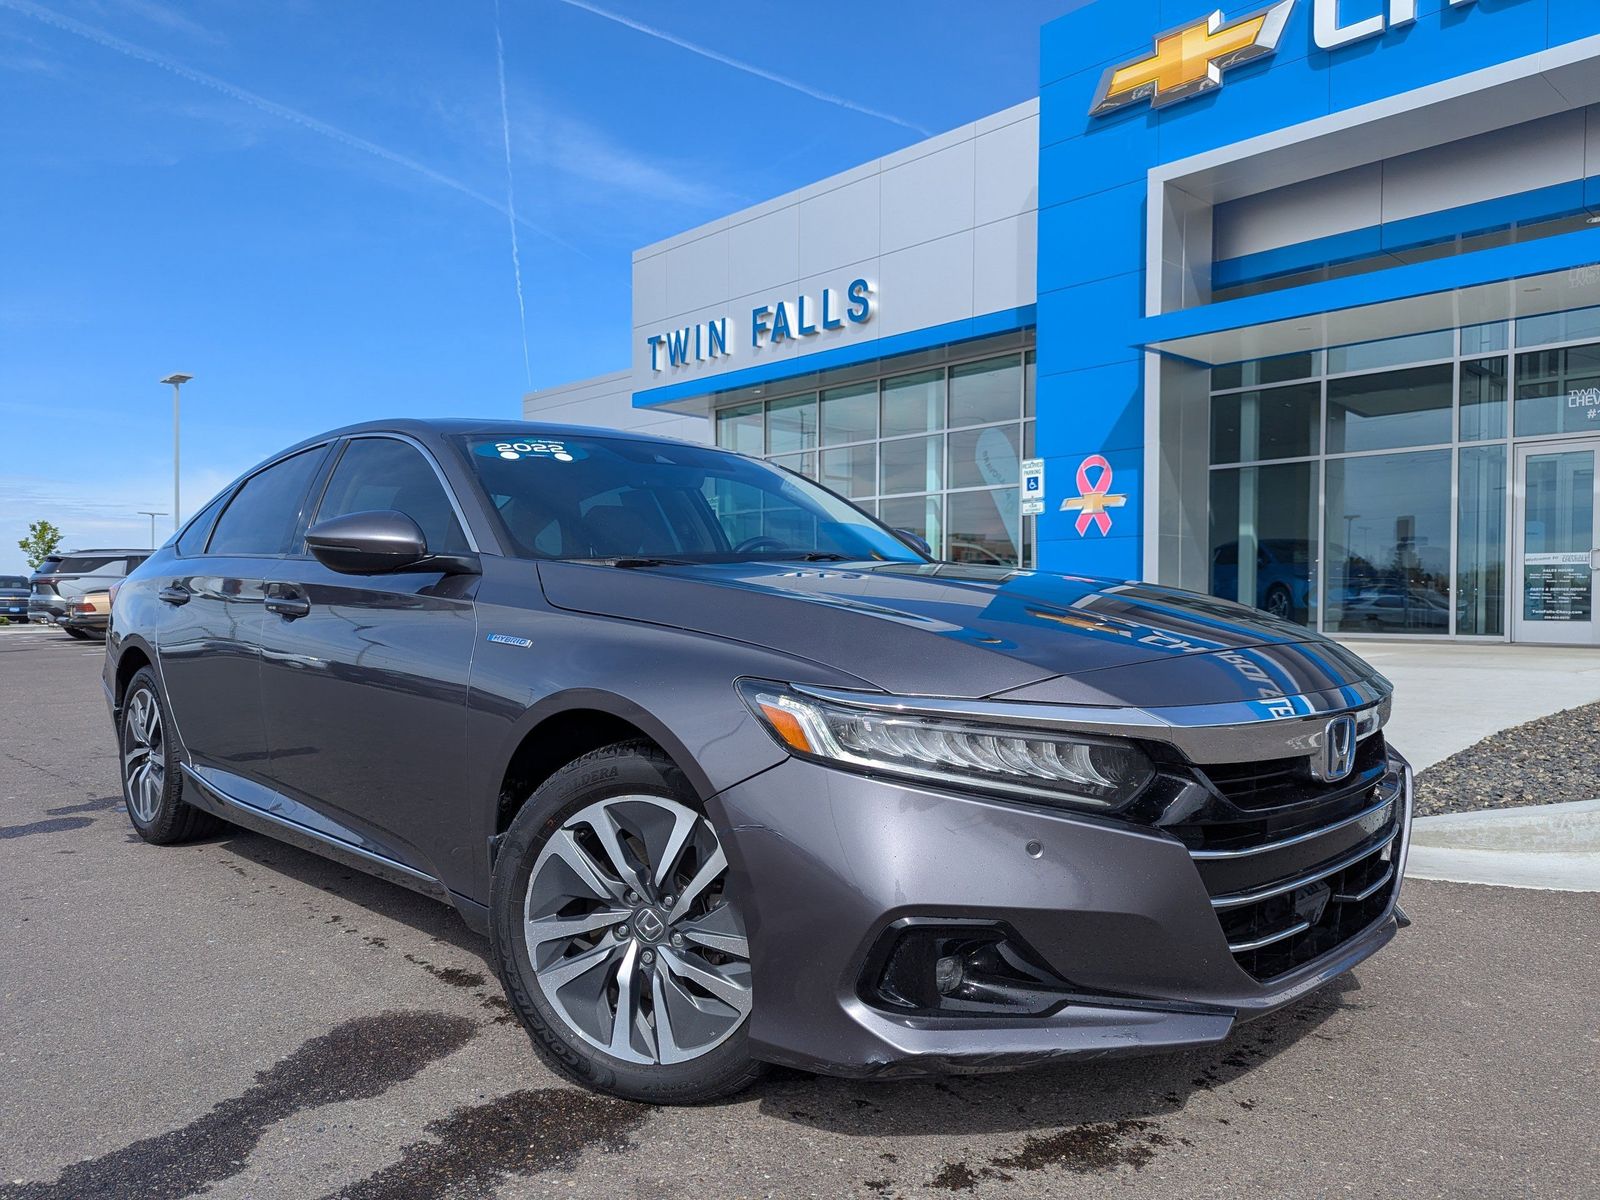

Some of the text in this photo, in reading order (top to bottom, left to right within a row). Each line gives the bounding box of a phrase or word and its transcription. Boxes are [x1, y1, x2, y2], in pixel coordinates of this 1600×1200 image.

[648, 278, 873, 372] TWIN FALLS
[495, 443, 568, 454] 2022
[491, 633, 529, 647] HYBRID
